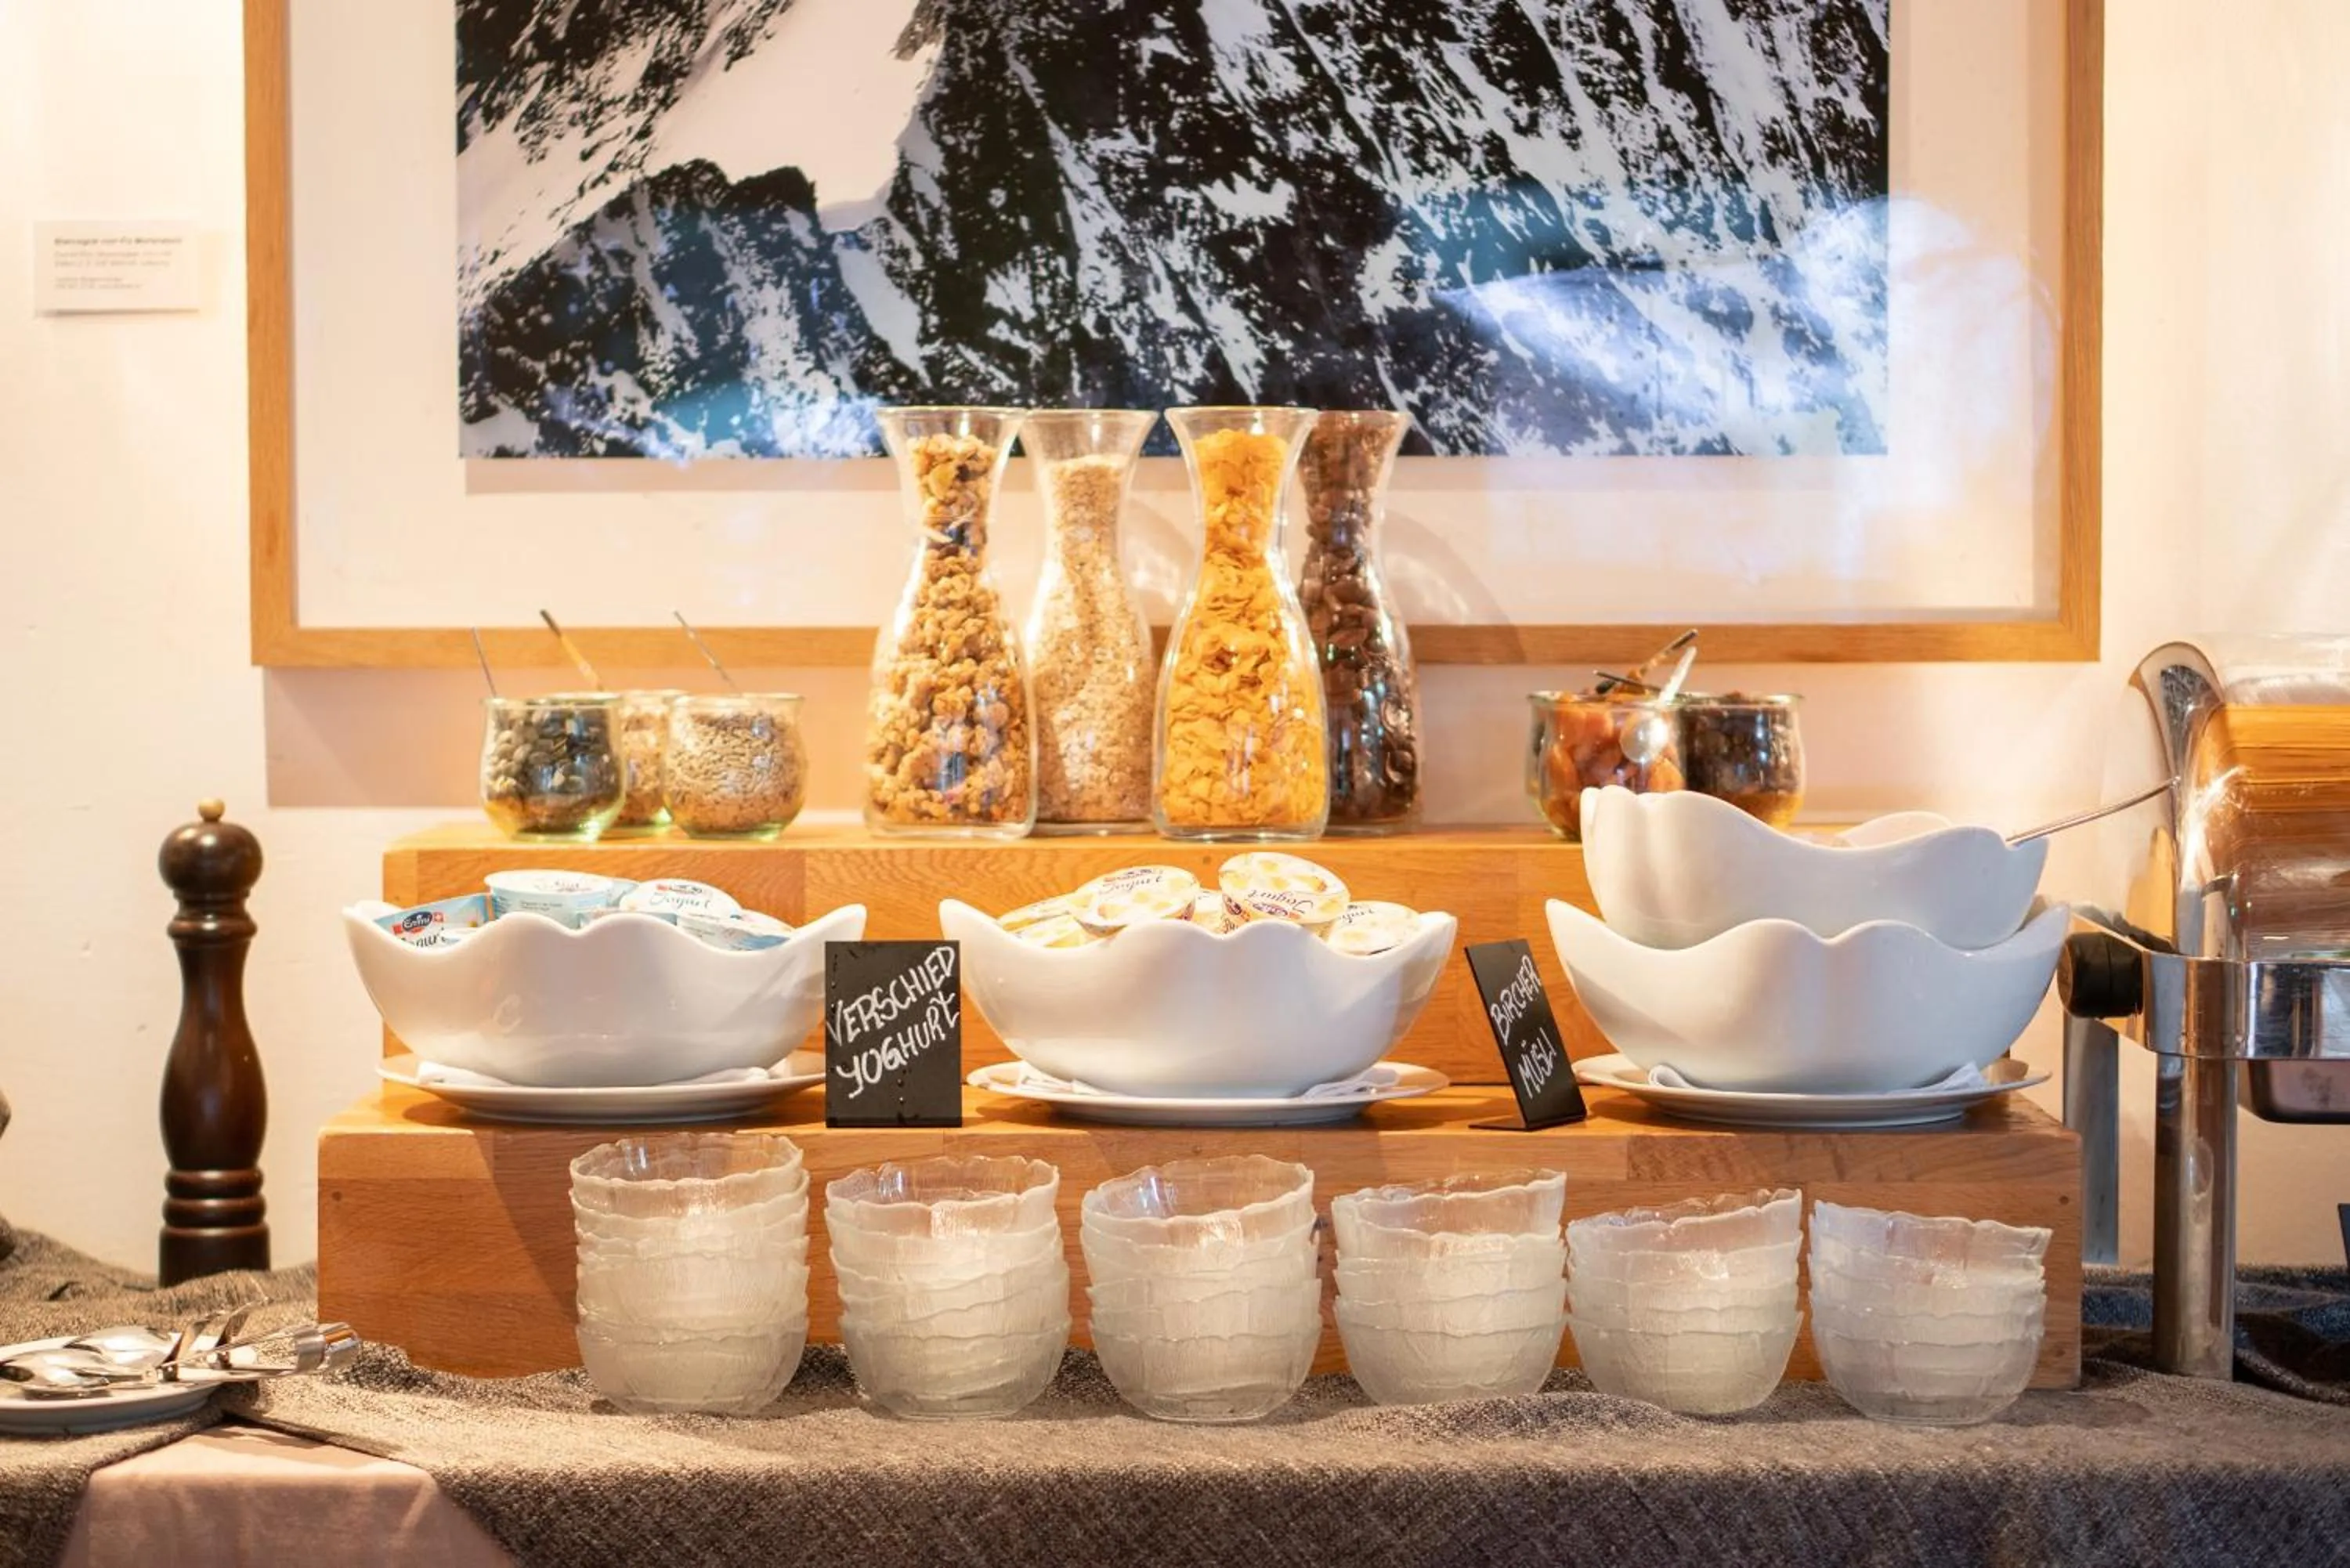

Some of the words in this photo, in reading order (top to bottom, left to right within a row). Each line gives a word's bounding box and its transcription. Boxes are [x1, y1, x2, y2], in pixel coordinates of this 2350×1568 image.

[403, 912, 431, 930] Emmi
[826, 946, 955, 1046] VERSCHIED
[1490, 954, 1542, 1046] BIRCHER
[836, 991, 960, 1098] YOGHURT
